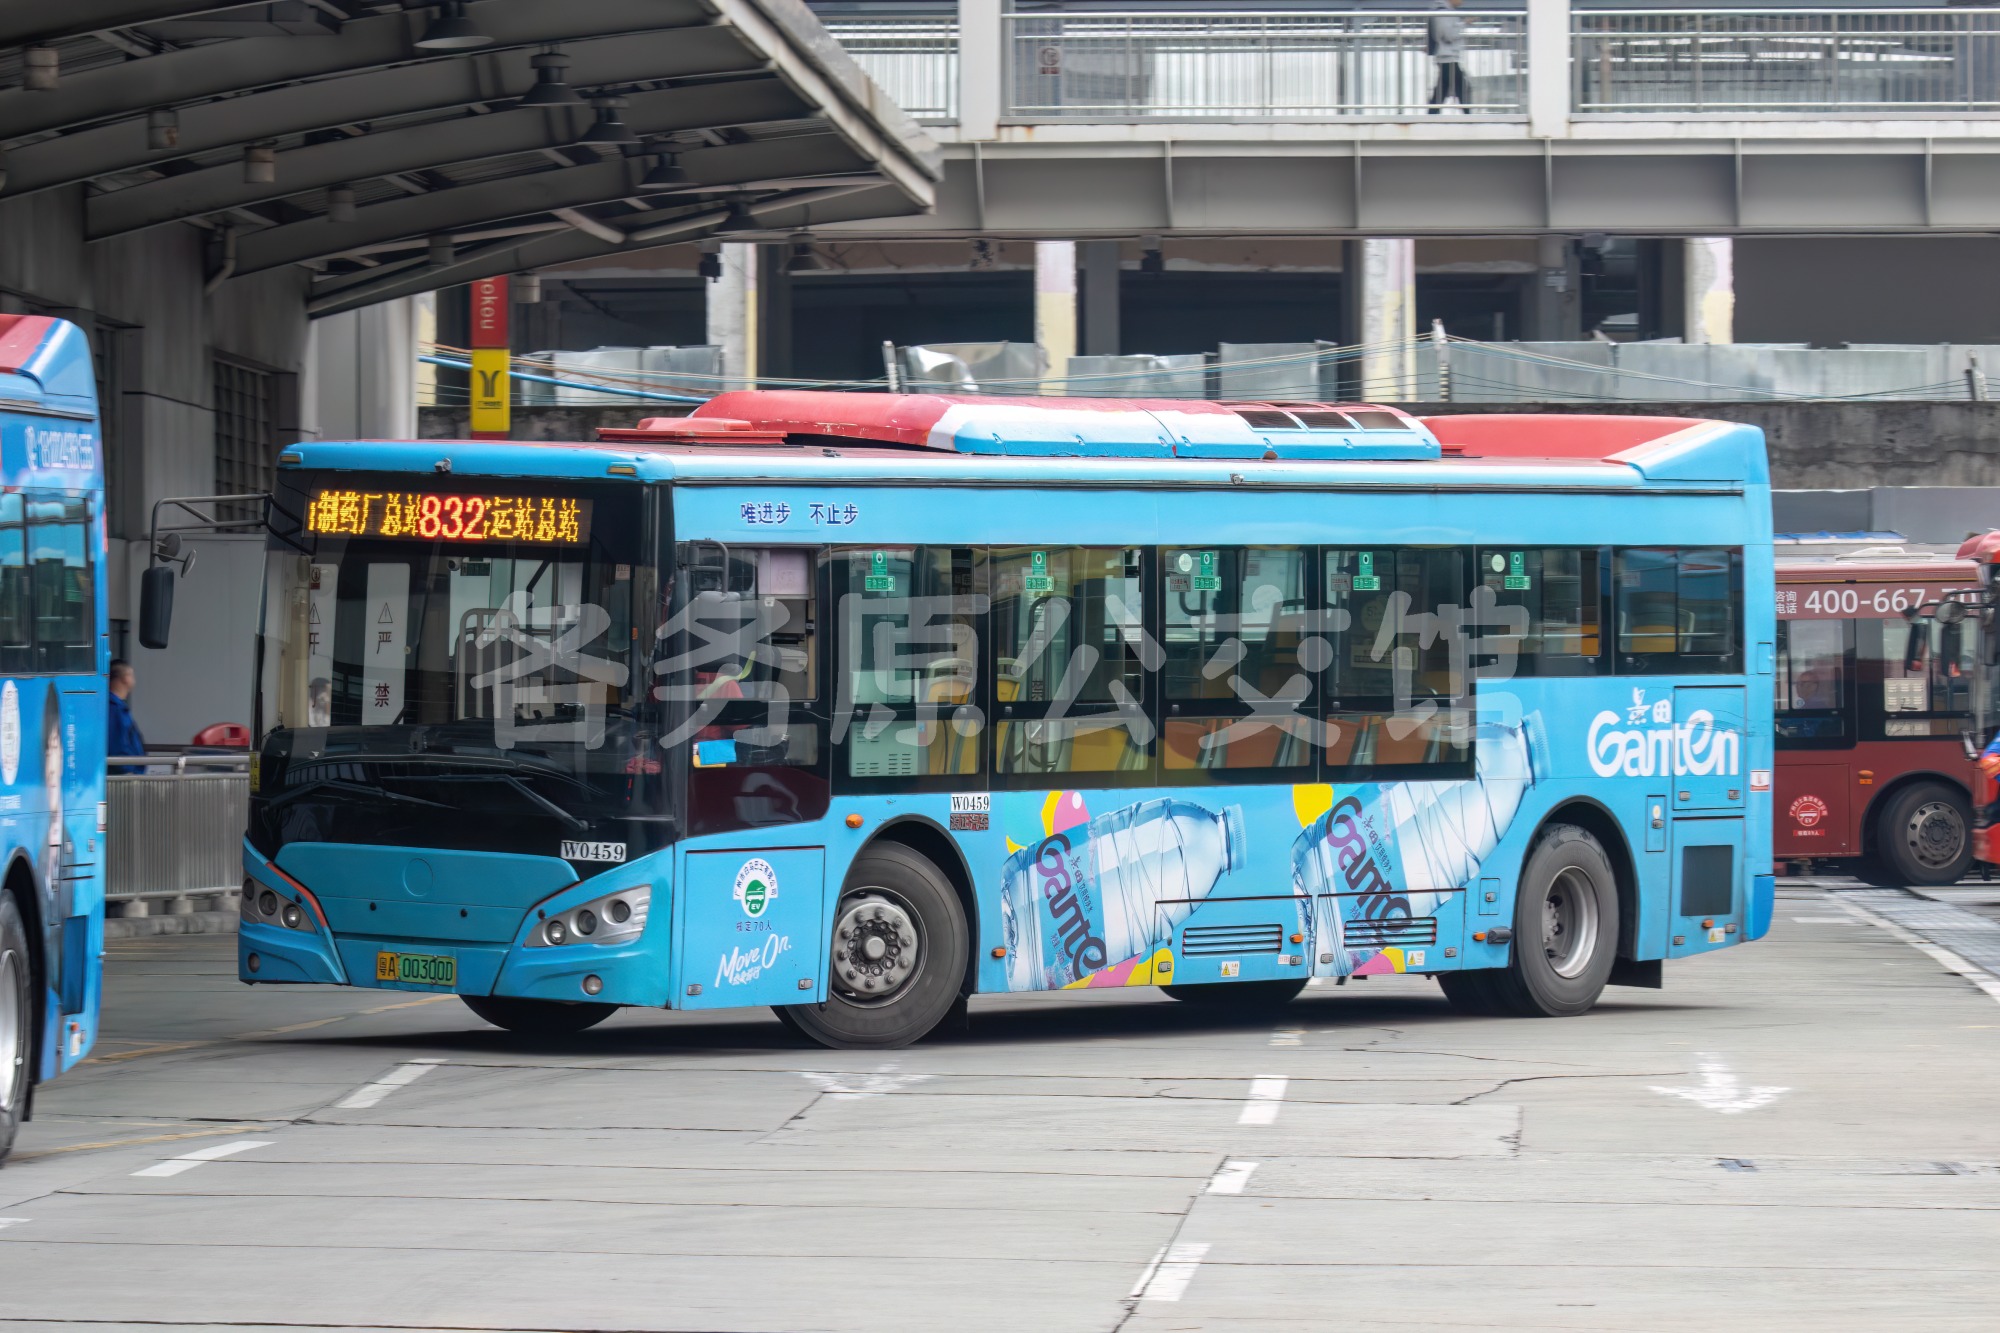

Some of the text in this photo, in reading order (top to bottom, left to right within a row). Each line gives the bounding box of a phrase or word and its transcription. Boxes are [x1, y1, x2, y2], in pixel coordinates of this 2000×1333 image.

[480, 278, 498, 329] okou
[418, 494, 486, 539] 832
[740, 502, 859, 525] 唯进步 不止步
[1588, 709, 1740, 778] Ganten
[952, 796, 990, 811] W0459
[562, 841, 626, 861] W0459
[714, 946, 760, 988] Move
